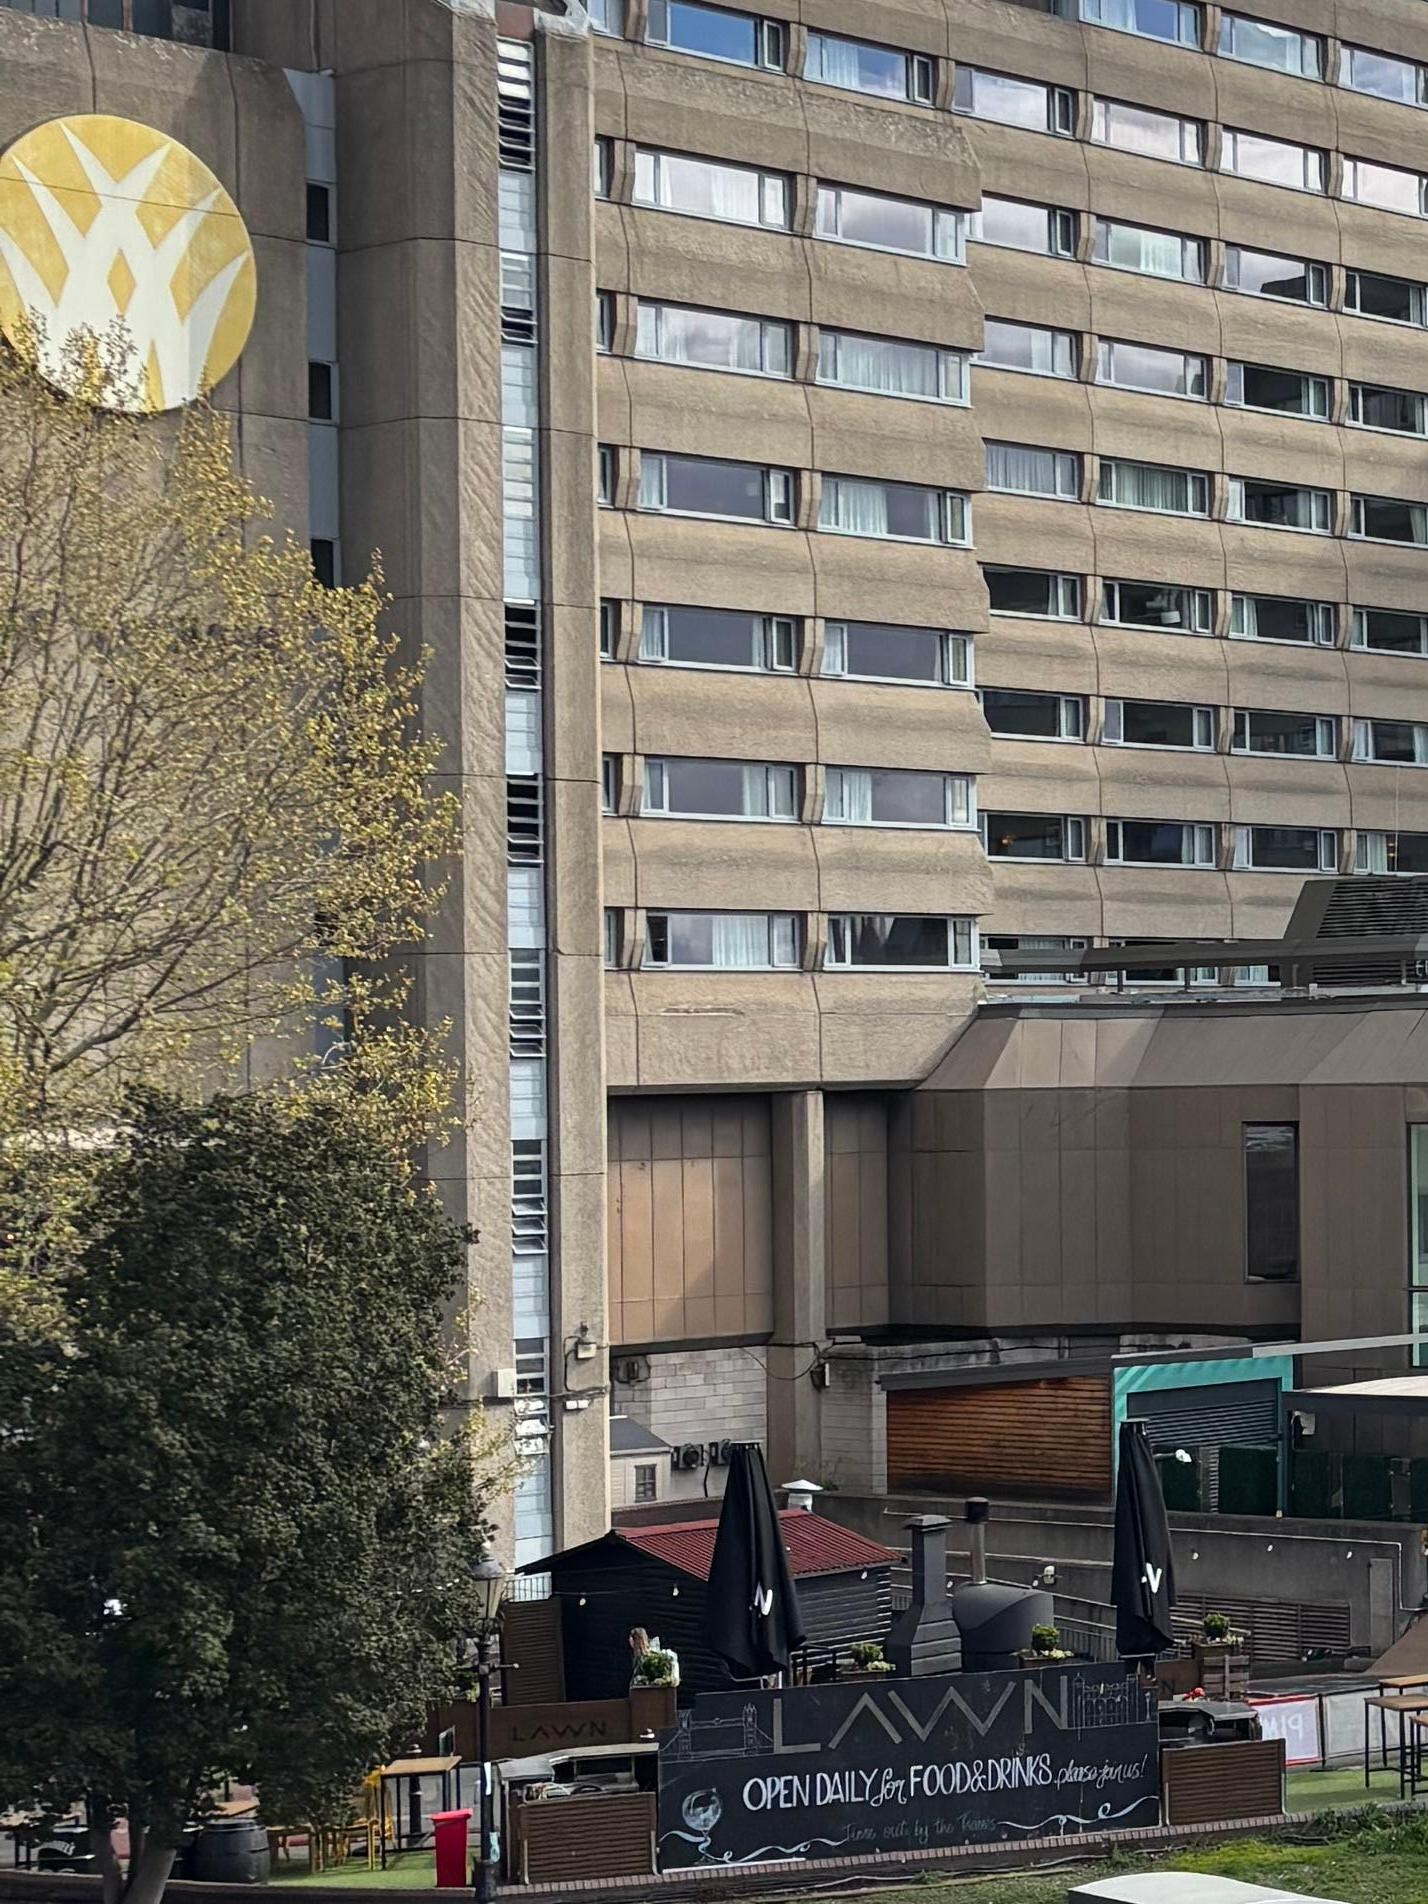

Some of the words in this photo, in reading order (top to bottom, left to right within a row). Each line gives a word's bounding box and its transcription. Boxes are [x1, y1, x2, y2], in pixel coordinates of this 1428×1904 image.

[512, 1720, 606, 1742] LAWN
[773, 1675, 1069, 1754] LAWN
[742, 1774, 810, 1811] OPEN
[816, 1768, 878, 1806] DAILY
[870, 1767, 907, 1807] for
